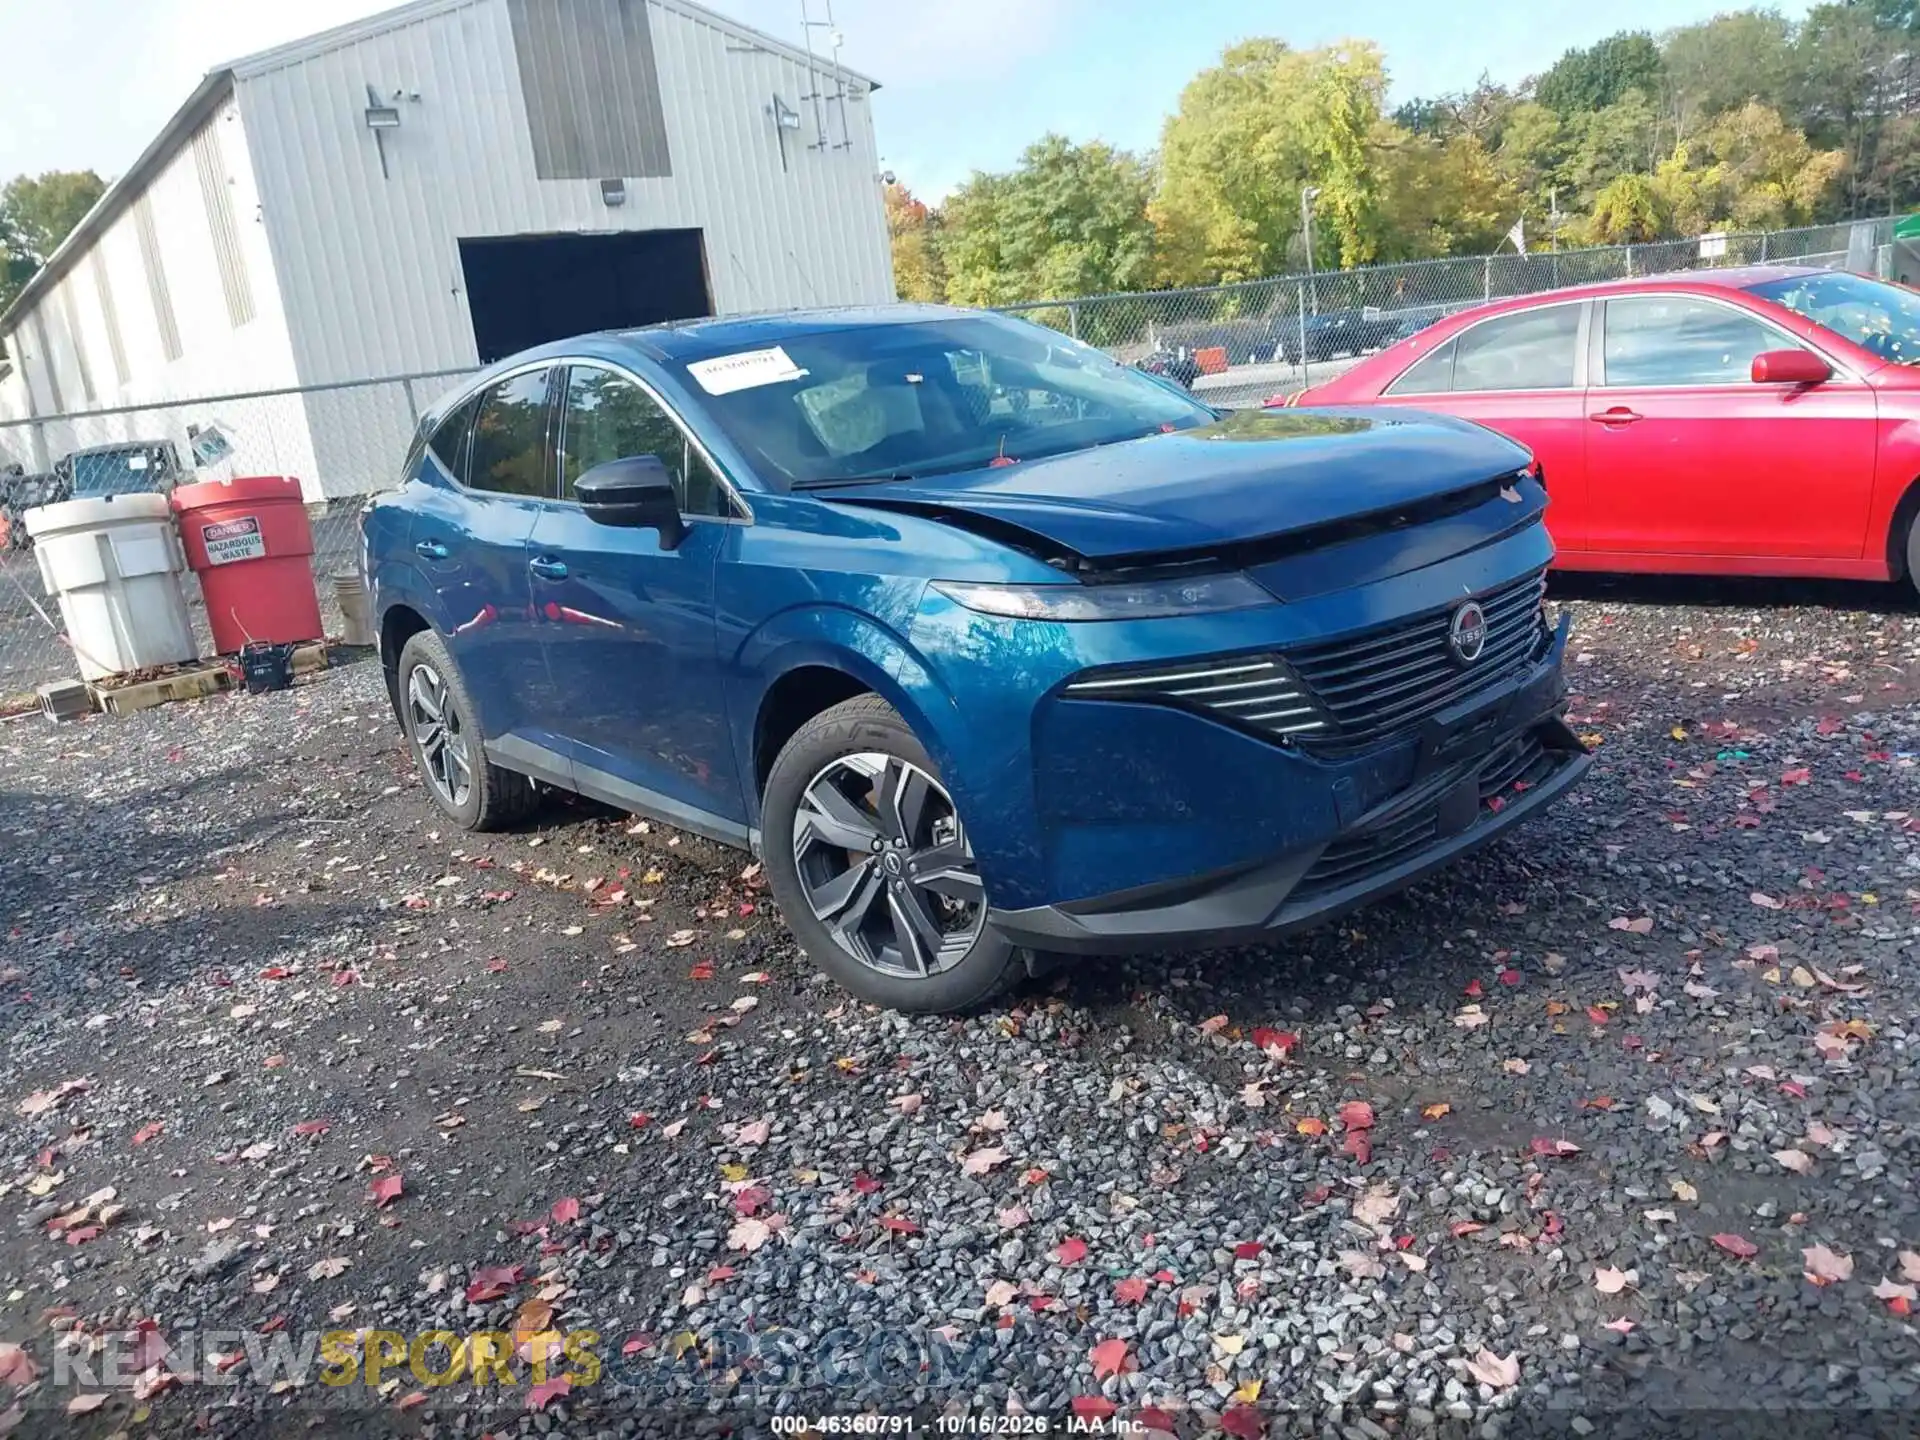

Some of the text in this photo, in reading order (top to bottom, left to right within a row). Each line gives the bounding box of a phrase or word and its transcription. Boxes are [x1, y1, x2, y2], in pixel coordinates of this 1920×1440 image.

[209, 522, 250, 538] DANGER
[208, 535, 263, 553] HAZARDOUS
[221, 546, 252, 560] WASTE
